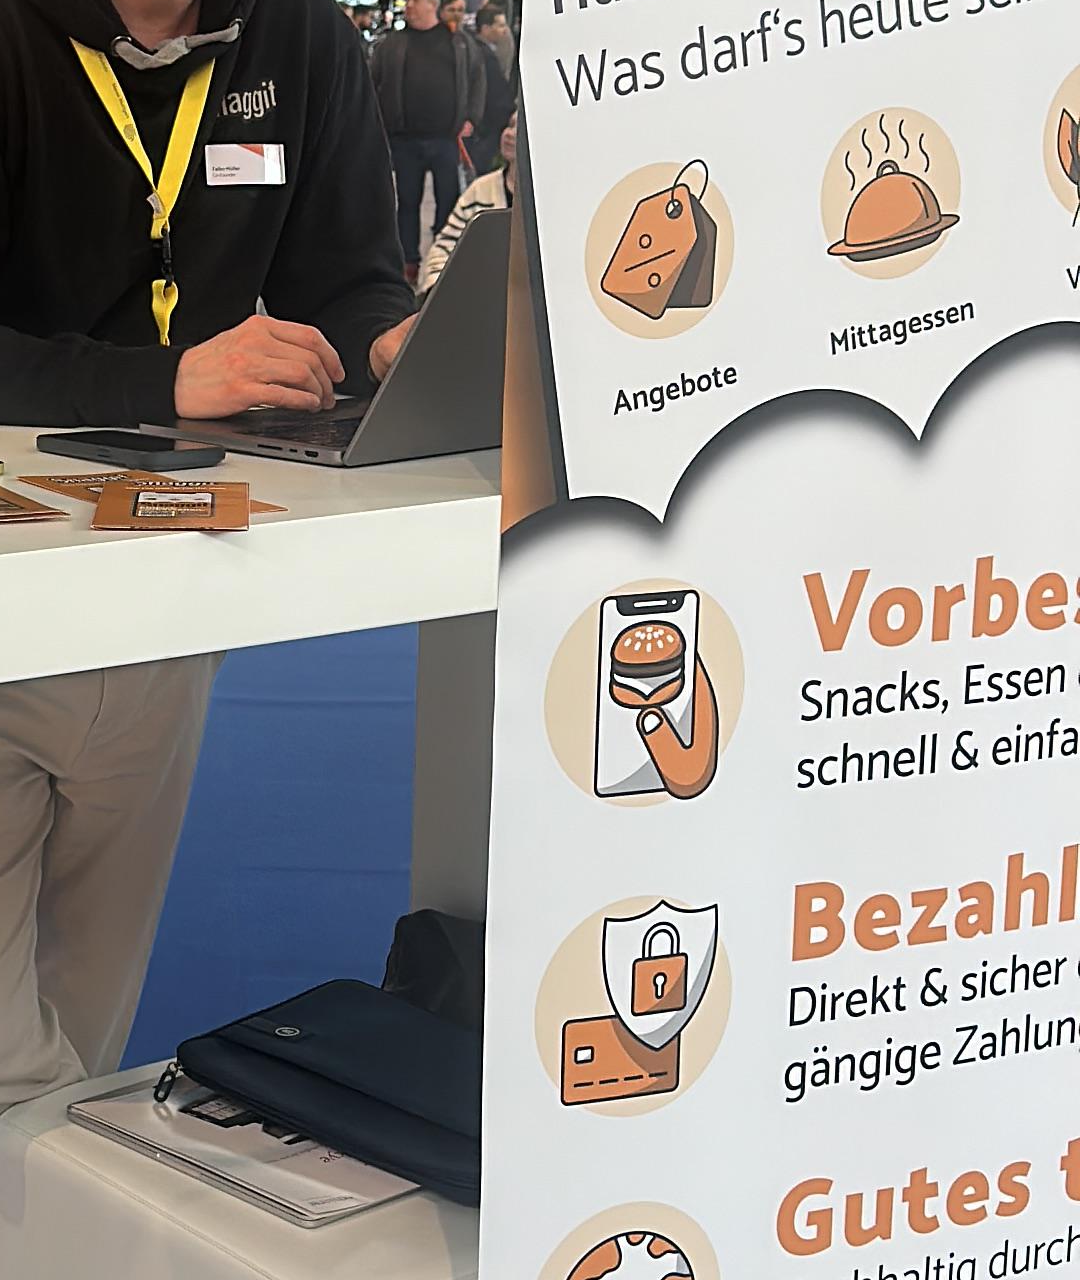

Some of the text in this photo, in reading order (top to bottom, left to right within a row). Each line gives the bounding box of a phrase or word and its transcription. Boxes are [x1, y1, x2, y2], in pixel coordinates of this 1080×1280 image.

[556, 50, 665, 108] Was
[830, 298, 975, 356] Mittagessen
[614, 363, 739, 416] Angebote
[803, 556, 1080, 653] Vorbe
[800, 663, 1066, 723] Snacks, Essen
[796, 718, 1079, 789] schnell & einfa
[792, 844, 1078, 961] Bezahl
[788, 954, 1067, 1029] Direkt & sicher
[784, 1013, 1080, 1102] gängige Zahlun
[776, 1160, 1032, 1257] Gutes
